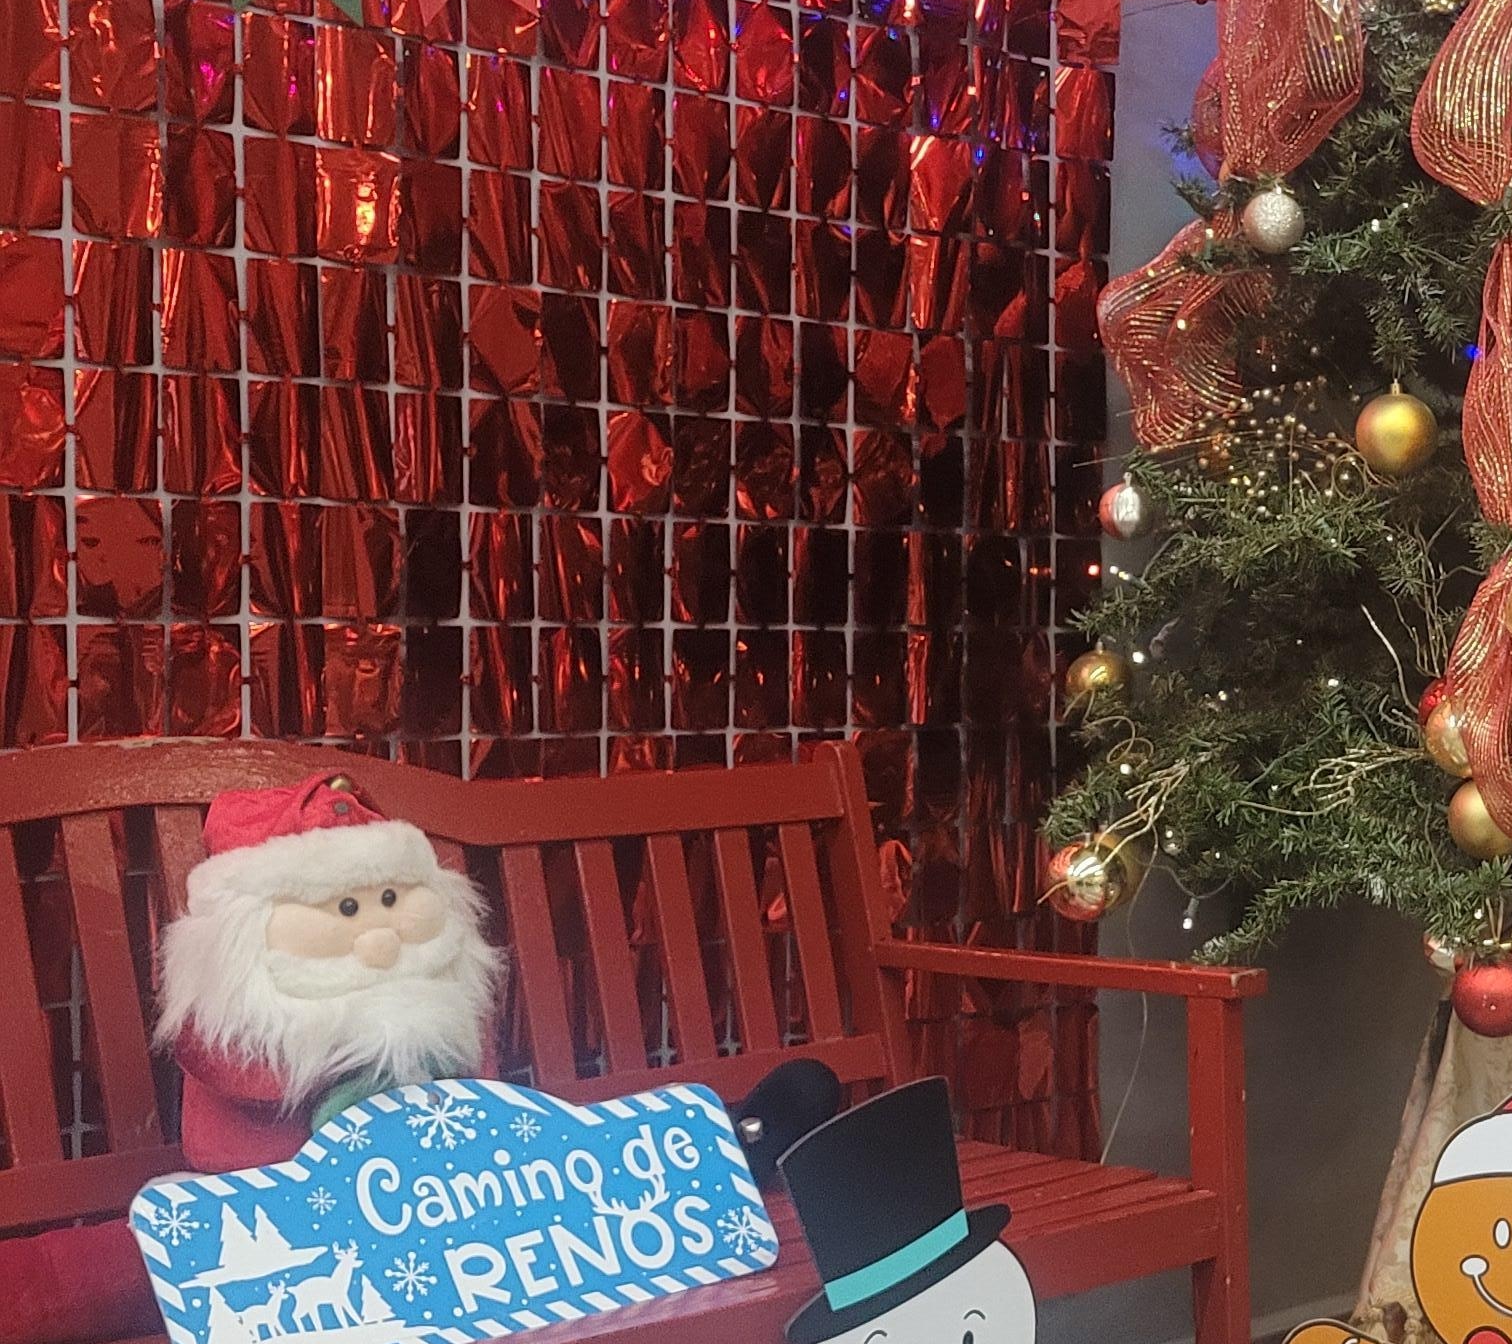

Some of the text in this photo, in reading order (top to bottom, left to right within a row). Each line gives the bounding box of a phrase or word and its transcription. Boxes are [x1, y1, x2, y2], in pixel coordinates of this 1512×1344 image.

[355, 1123, 701, 1236] Camino de
[443, 1195, 715, 1315] RENOS
